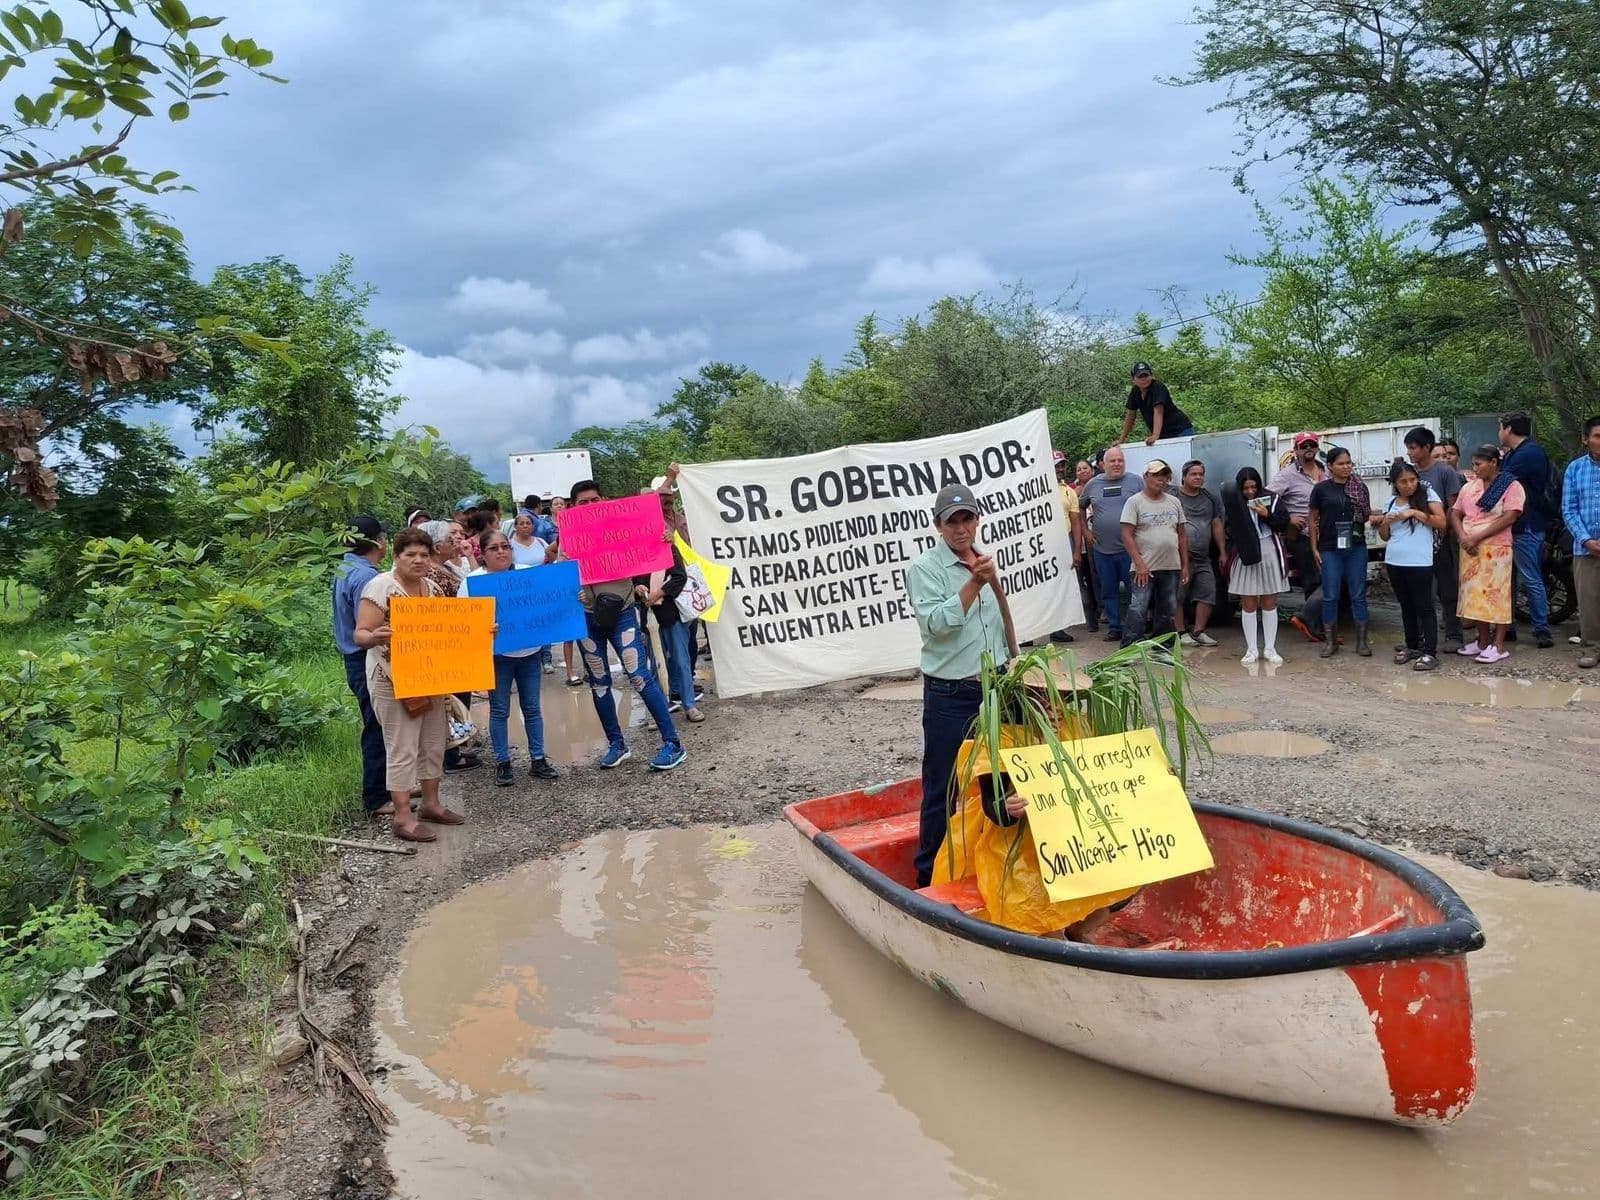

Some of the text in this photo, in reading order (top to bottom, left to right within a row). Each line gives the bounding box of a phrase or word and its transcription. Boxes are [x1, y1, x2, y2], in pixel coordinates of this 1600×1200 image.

[711, 530, 801, 560] ESTAMOS
[804, 514, 878, 550] PIDIENDO
[881, 508, 930, 534] APOYO
[1017, 473, 1052, 506] SOCIAL
[716, 440, 1036, 524] SR. GOBERNADOR:
[725, 566, 745, 590] A
[750, 545, 869, 588] REPARACIÓN
[873, 540, 911, 565] DEL
[981, 502, 1053, 545] CARRETERO
[741, 591, 789, 618] SAN
[996, 542, 1025, 571] QUE
[1029, 533, 1045, 558] SE
[737, 610, 854, 648] ENCUENTRA
[857, 602, 884, 628] EN
[1001, 557, 1059, 597] DICIONES
[1011, 753, 1036, 783] Si
[1093, 740, 1153, 770] arreglar
[1123, 772, 1147, 799] que
[1040, 842, 1074, 885] San
[1132, 827, 1176, 860] Higo
